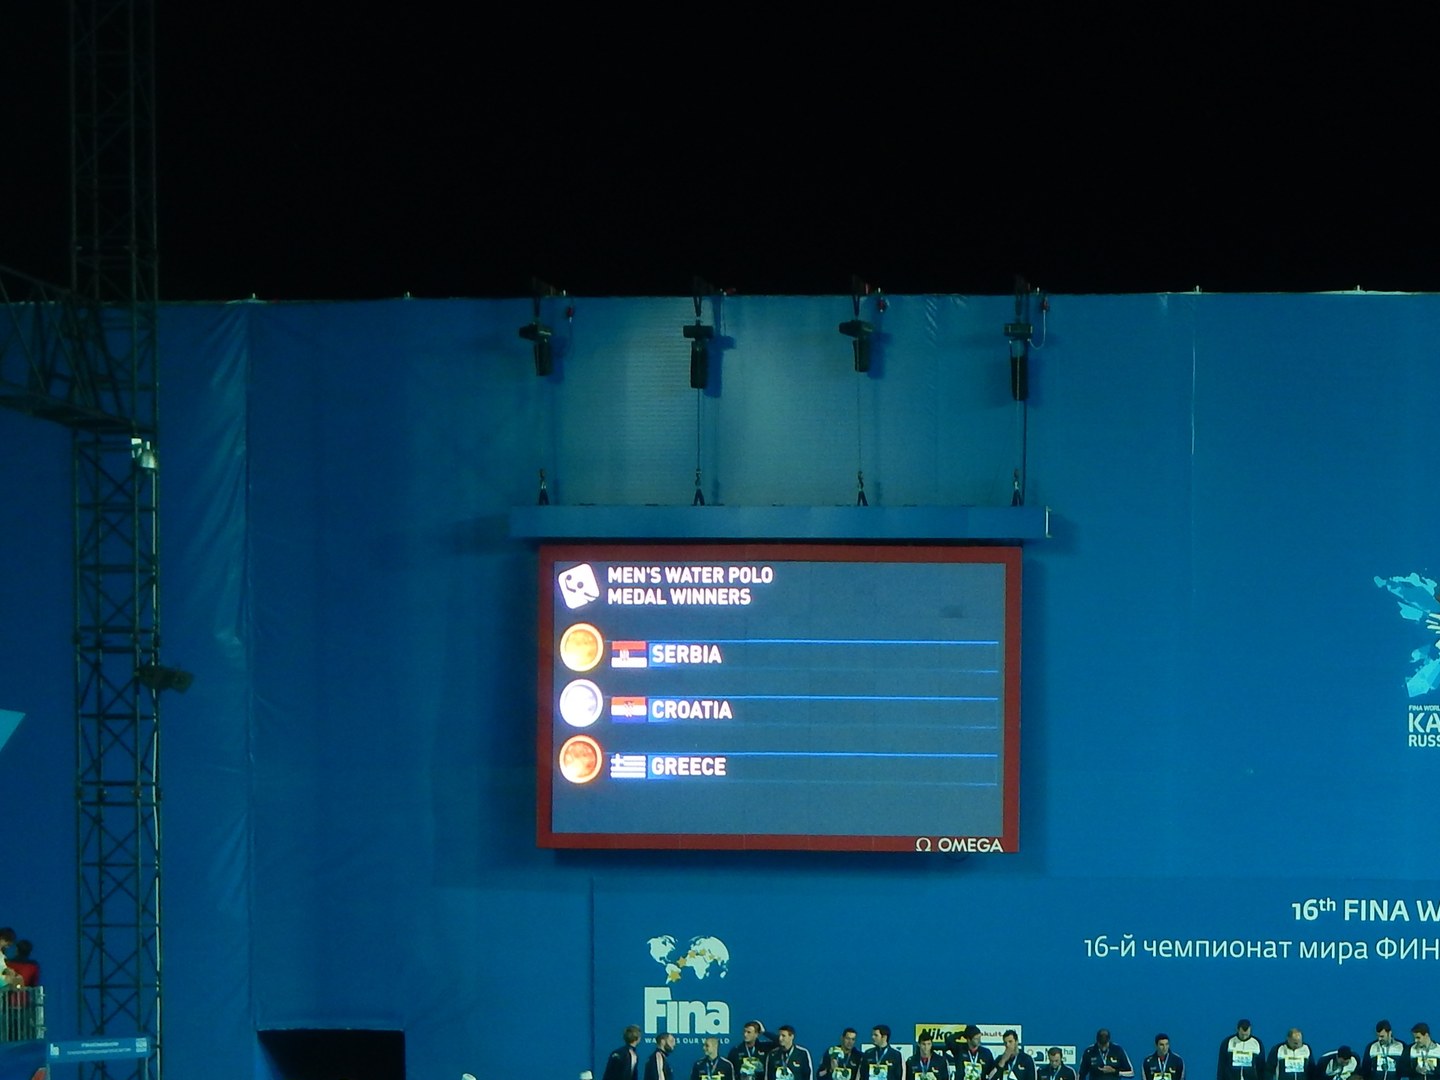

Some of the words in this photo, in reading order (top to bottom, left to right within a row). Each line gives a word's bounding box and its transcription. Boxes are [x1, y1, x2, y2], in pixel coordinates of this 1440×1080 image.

[607, 567, 662, 584] MEN'S
[665, 567, 725, 584] WATER
[728, 567, 773, 584] POLO
[607, 588, 667, 605] MEDAL
[670, 588, 751, 606] WINNERS
[652, 645, 722, 664] SERBIA
[652, 701, 732, 720] CROATIA
[1408, 704, 1423, 712] FINA
[652, 757, 727, 776] GREECE
[937, 838, 1004, 853] OMEGA
[1292, 897, 1336, 922] 16th
[1344, 900, 1410, 922] FINA
[1085, 934, 1136, 958] 16-й
[1144, 941, 1292, 959] чемпионат
[1300, 941, 1368, 965] мира
[644, 986, 730, 1035] Fina
[683, 1037, 699, 1045] OUR
[921, 1028, 960, 1041] Niko
